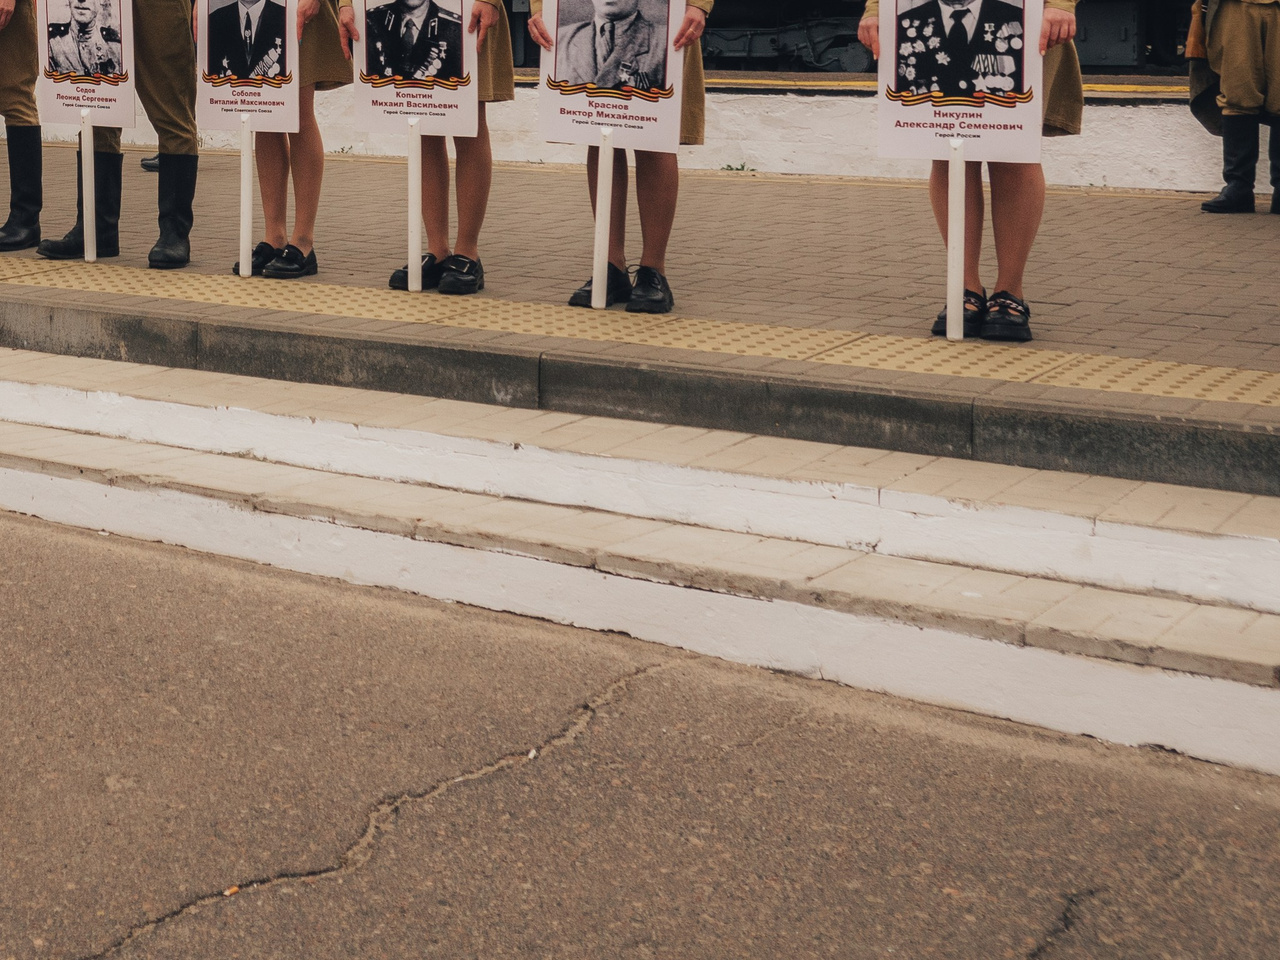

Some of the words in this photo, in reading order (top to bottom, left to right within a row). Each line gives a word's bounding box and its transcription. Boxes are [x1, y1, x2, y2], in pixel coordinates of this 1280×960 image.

[75, 86, 96, 94] Седов
[81, 95, 117, 103] Сергеевич
[395, 91, 433, 100] Копытин
[240, 99, 285, 107] Максимович
[371, 100, 405, 108] Михаил
[406, 101, 459, 110] Васильевич
[588, 100, 629, 111] Краснов
[560, 107, 594, 118] Виктор
[596, 110, 658, 123] Михайлович
[933, 110, 983, 120] Никулин
[894, 120, 956, 130] Александр
[959, 121, 1023, 131] Семенович
